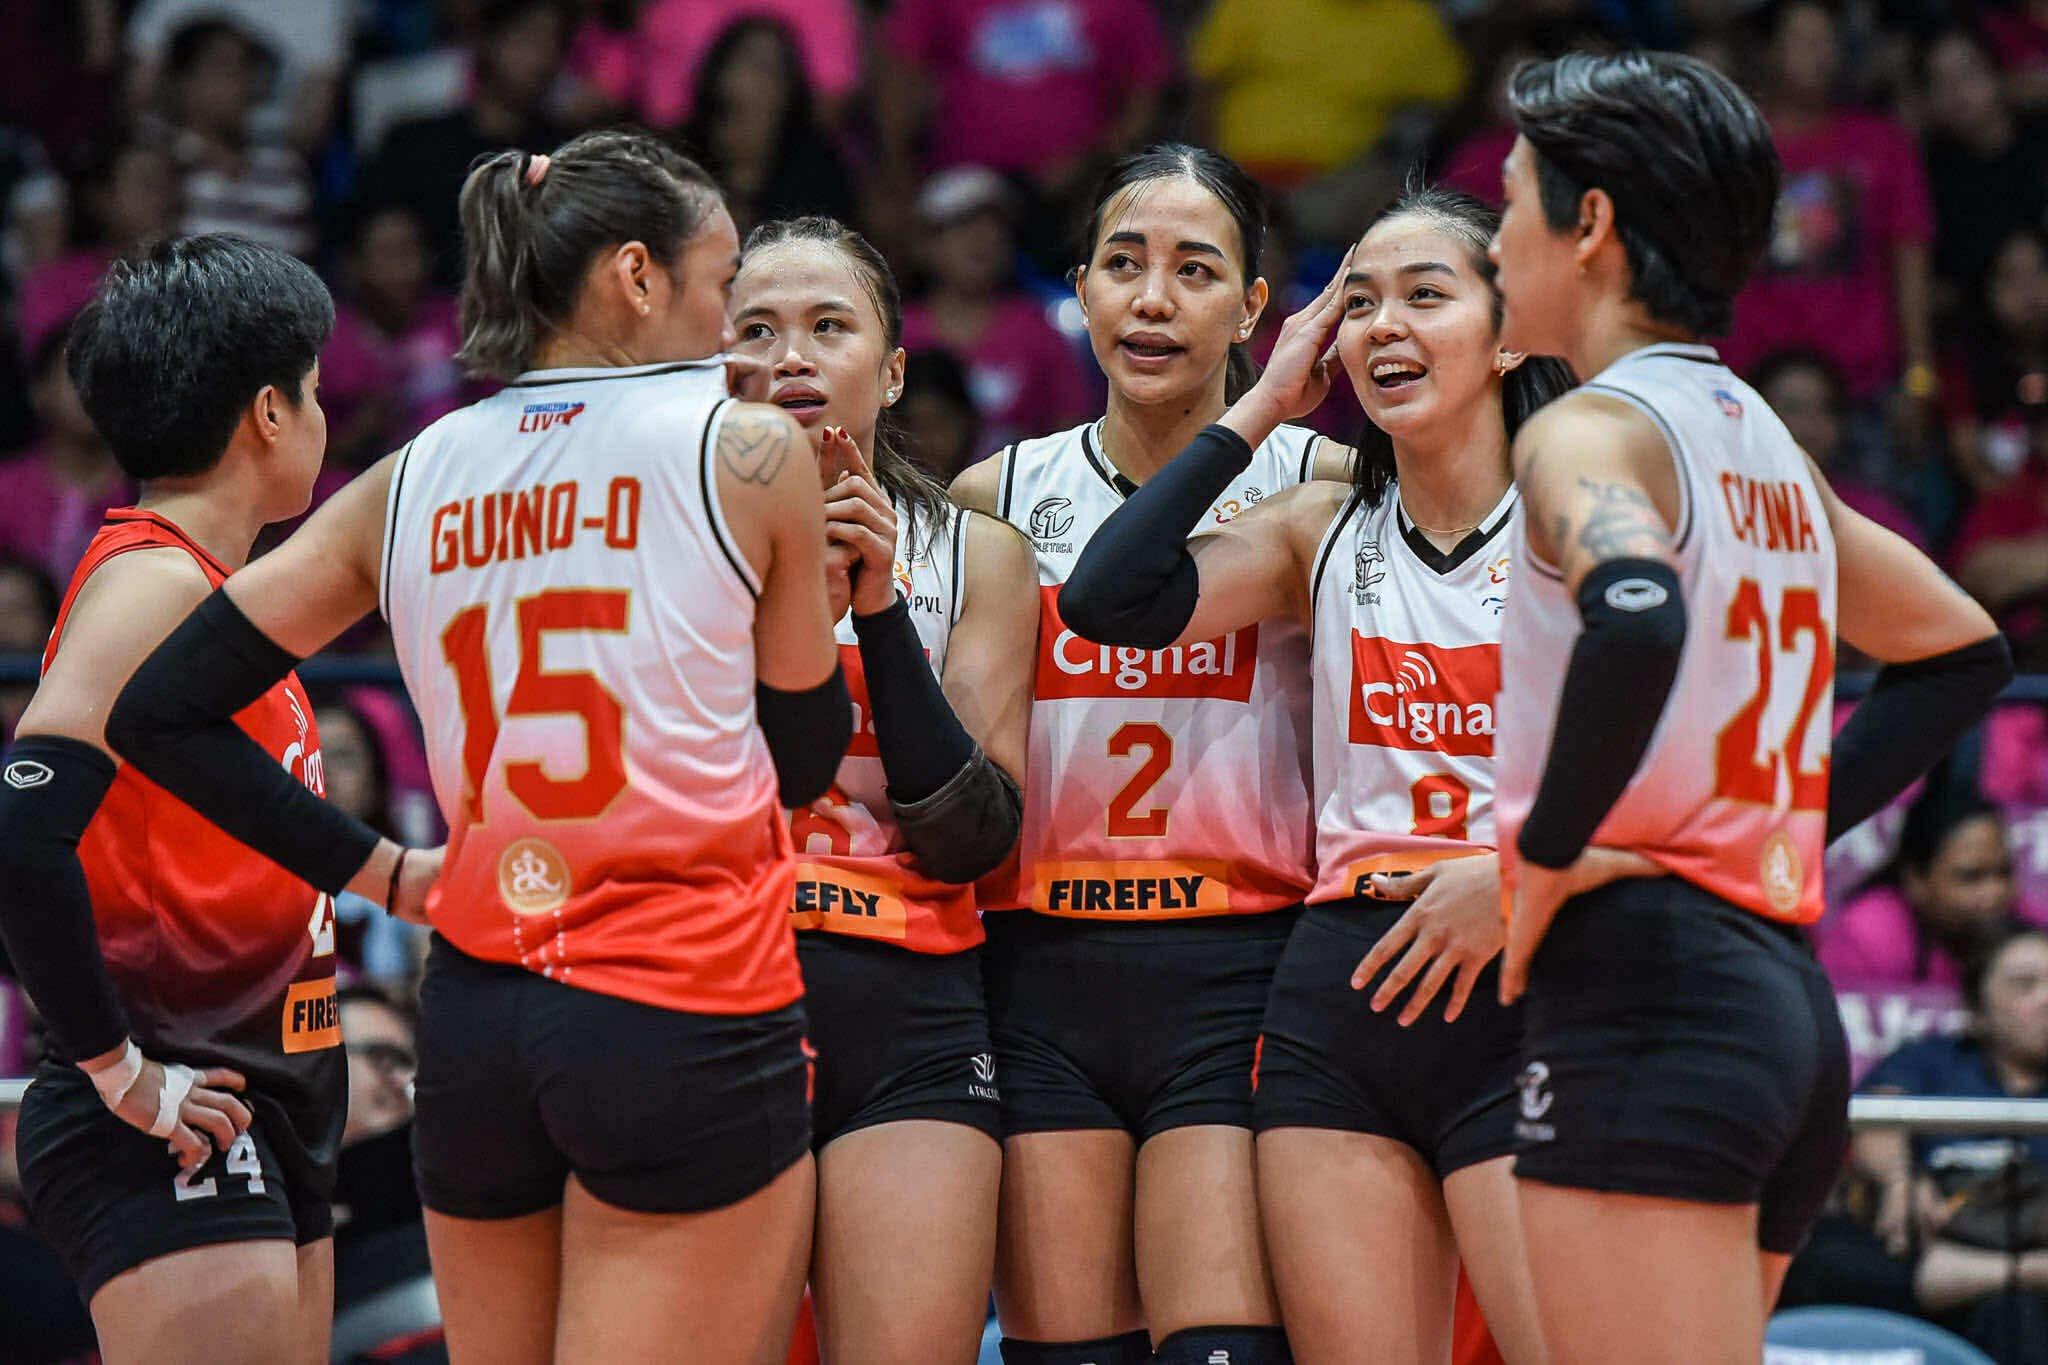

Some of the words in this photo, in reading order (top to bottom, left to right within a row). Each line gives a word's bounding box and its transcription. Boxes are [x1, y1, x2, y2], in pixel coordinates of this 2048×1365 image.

[430, 476, 642, 576] GUINO-O
[914, 595, 943, 615] PVL
[1053, 628, 1237, 690] Cignal
[439, 585, 633, 828] 15
[1361, 682, 1498, 745] Cigna
[1712, 576, 1835, 812] 22
[1106, 719, 1175, 841] 2
[790, 880, 881, 919] EFLY
[1047, 874, 1206, 912] FIREFLY
[167, 1129, 266, 1202] 24
